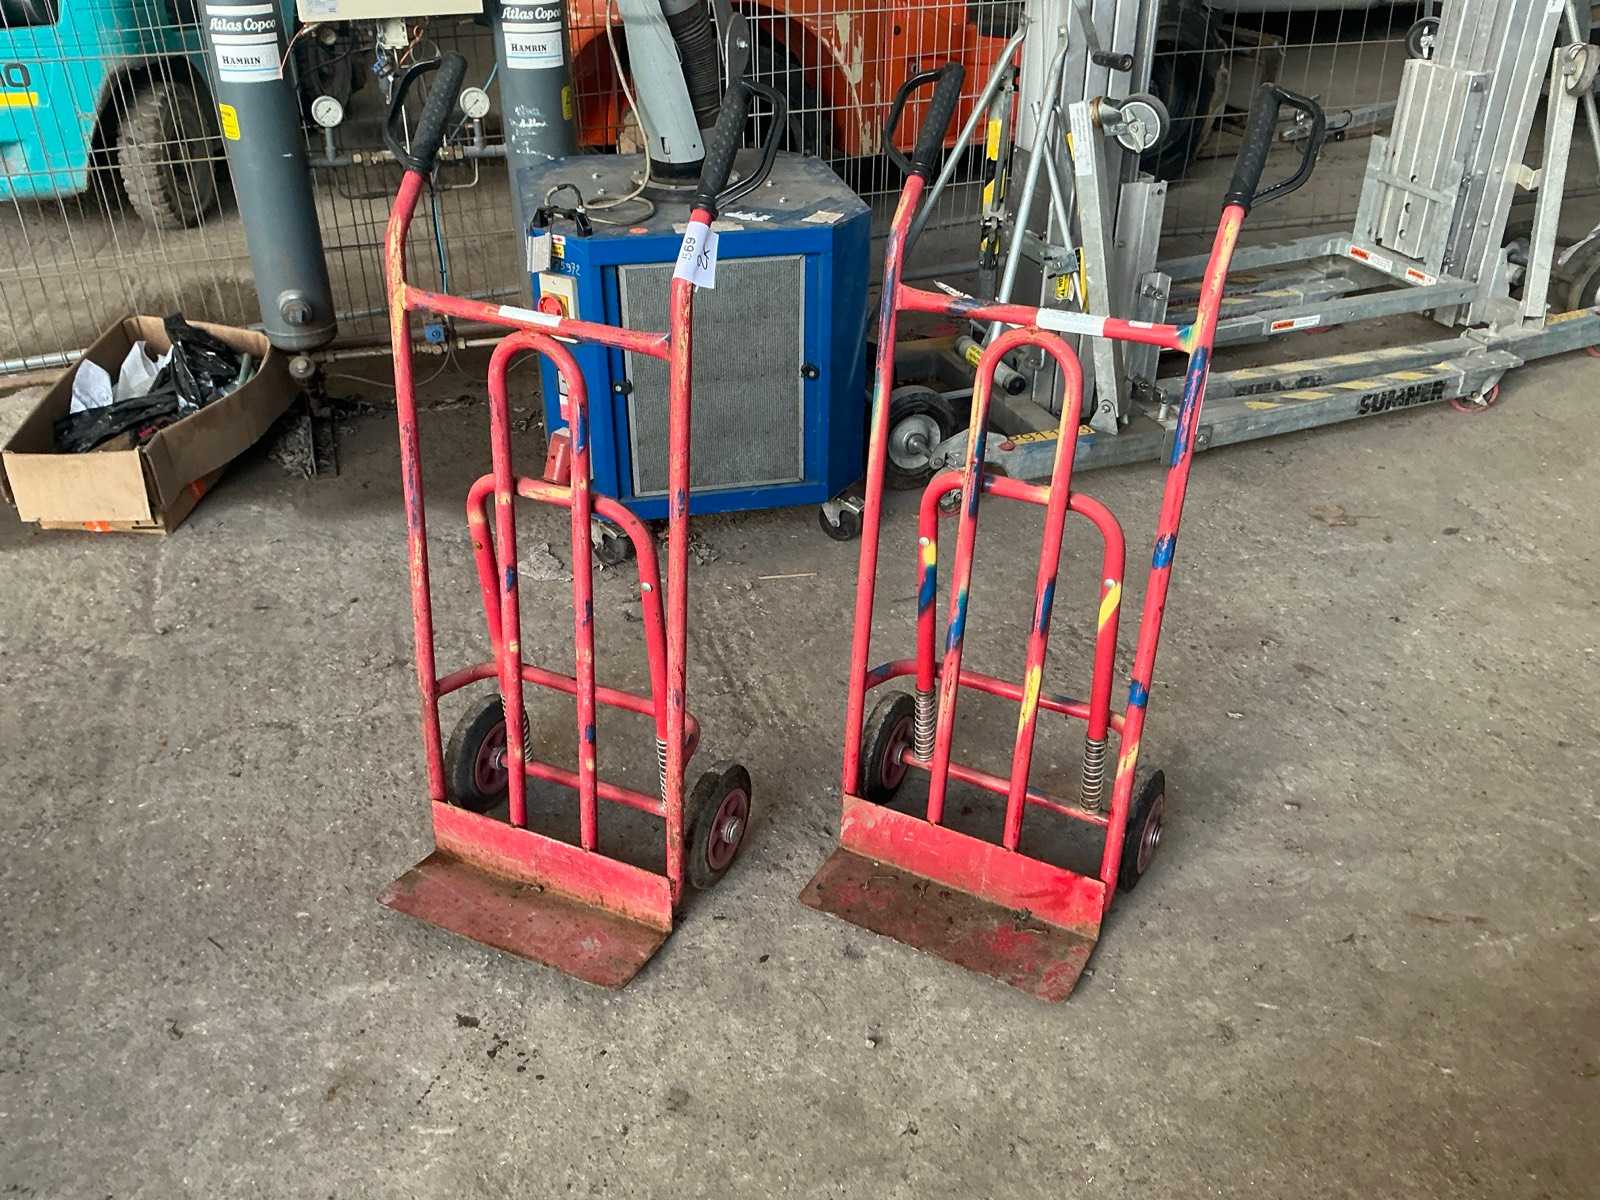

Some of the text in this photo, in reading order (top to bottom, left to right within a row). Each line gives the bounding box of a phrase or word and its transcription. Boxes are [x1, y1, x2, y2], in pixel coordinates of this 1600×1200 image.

[502, 6, 534, 19] Atlas
[210, 17, 275, 32] Atlas Copco
